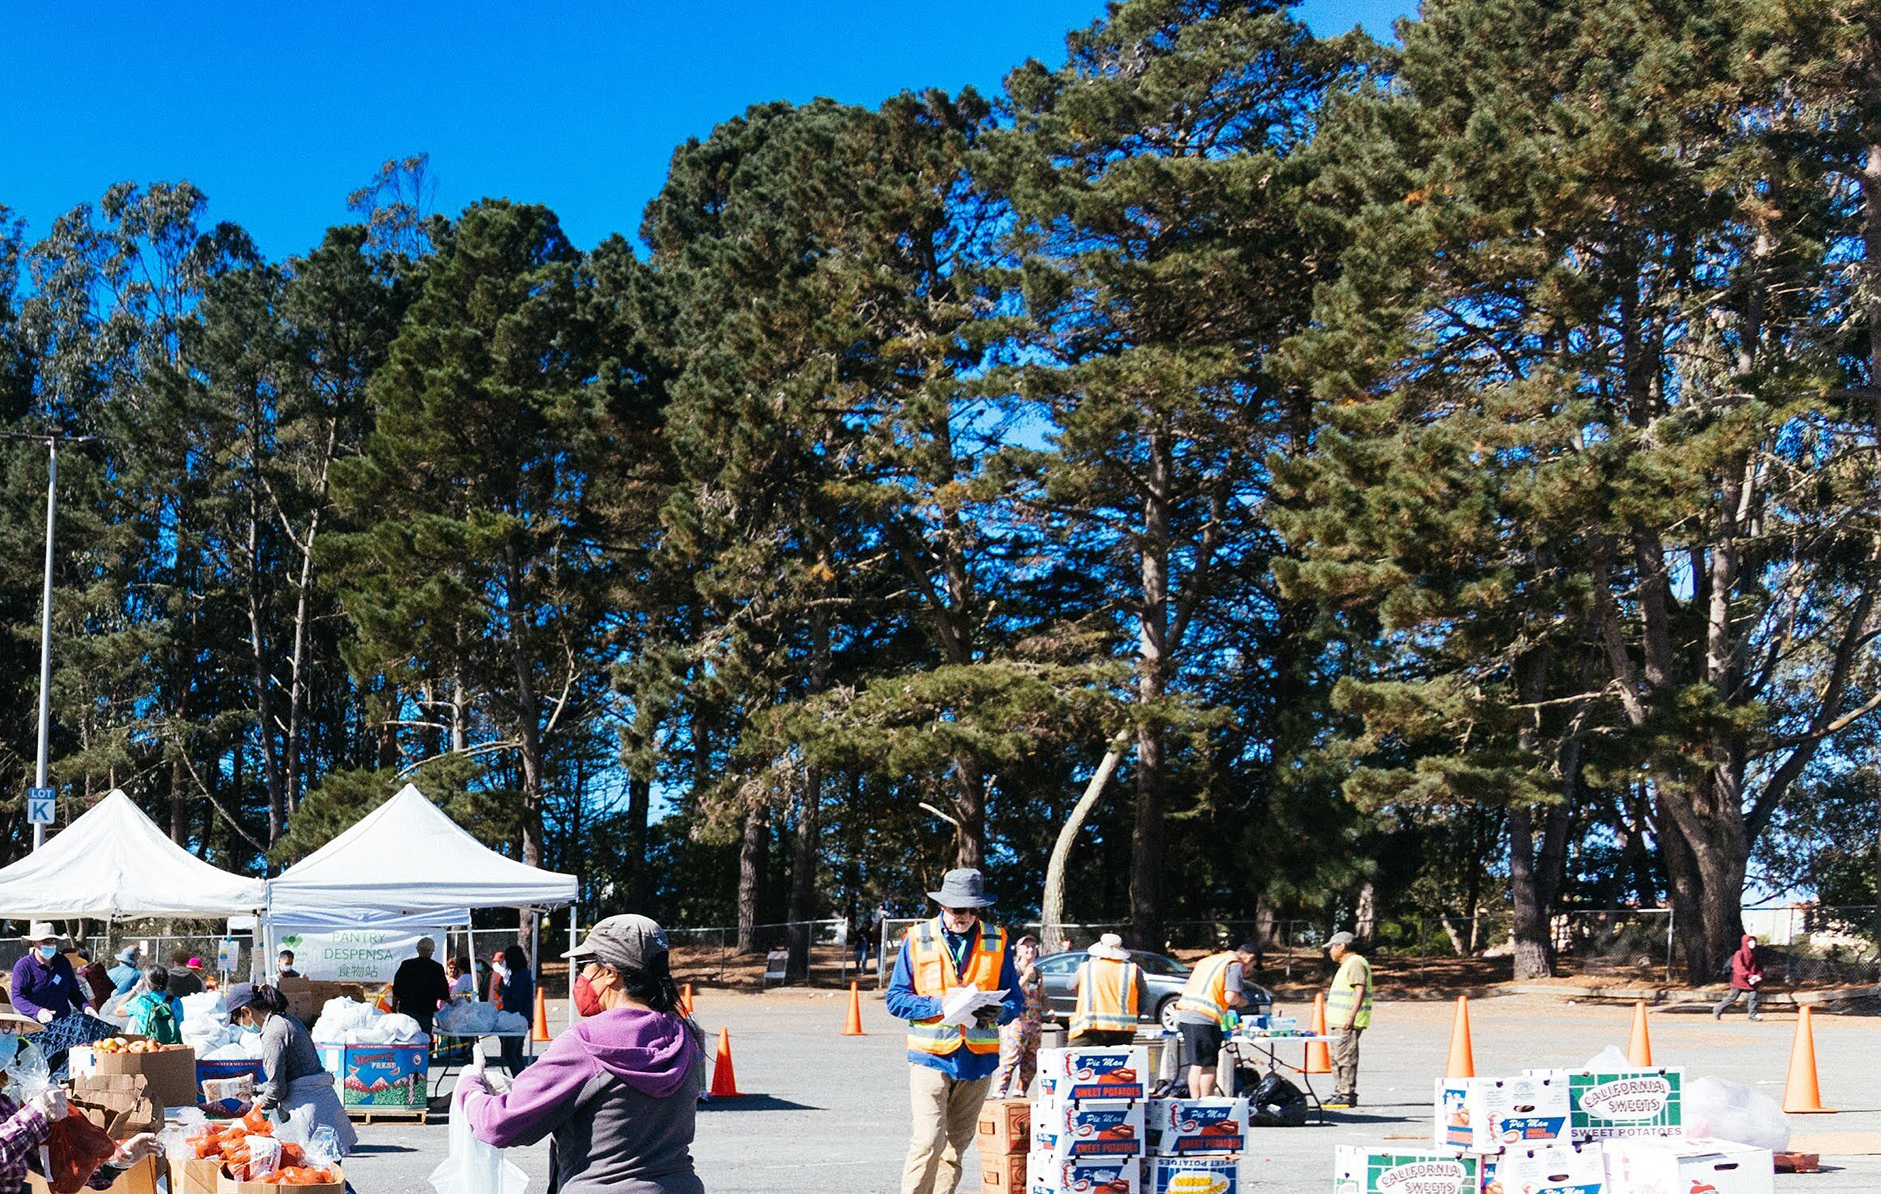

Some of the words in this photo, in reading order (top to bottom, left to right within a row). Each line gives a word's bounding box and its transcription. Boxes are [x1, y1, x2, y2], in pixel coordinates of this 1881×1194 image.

[31, 789, 53, 798] LOT
[32, 801, 49, 820] K
[332, 931, 387, 943] PANTRY
[324, 948, 394, 961] DESPENSA
[1085, 1057, 1102, 1068] Pie
[1102, 1057, 1124, 1067] Man
[1075, 1087, 1101, 1097] SWEET
[1103, 1087, 1141, 1097] POTATOES
[1584, 1080, 1666, 1107] CALIFORNIA
[1608, 1099, 1661, 1113] SWEETS
[1086, 1114, 1101, 1124] Pie
[1101, 1114, 1123, 1123] Man
[1190, 1109, 1205, 1120] Pie
[1205, 1109, 1228, 1119] Man
[1509, 1119, 1525, 1128] Pie
[1526, 1119, 1549, 1127] Man
[1571, 1129, 1614, 1137] SWEET
[1618, 1128, 1682, 1137] POTATOES
[1075, 1143, 1101, 1153] SWEET
[1103, 1142, 1138, 1152] POTATOES
[1179, 1138, 1204, 1148] SWEET
[1206, 1138, 1242, 1148] POTATOES
[1382, 1165, 1462, 1187] CALIFORNIA
[1405, 1182, 1456, 1194] SWEETS
